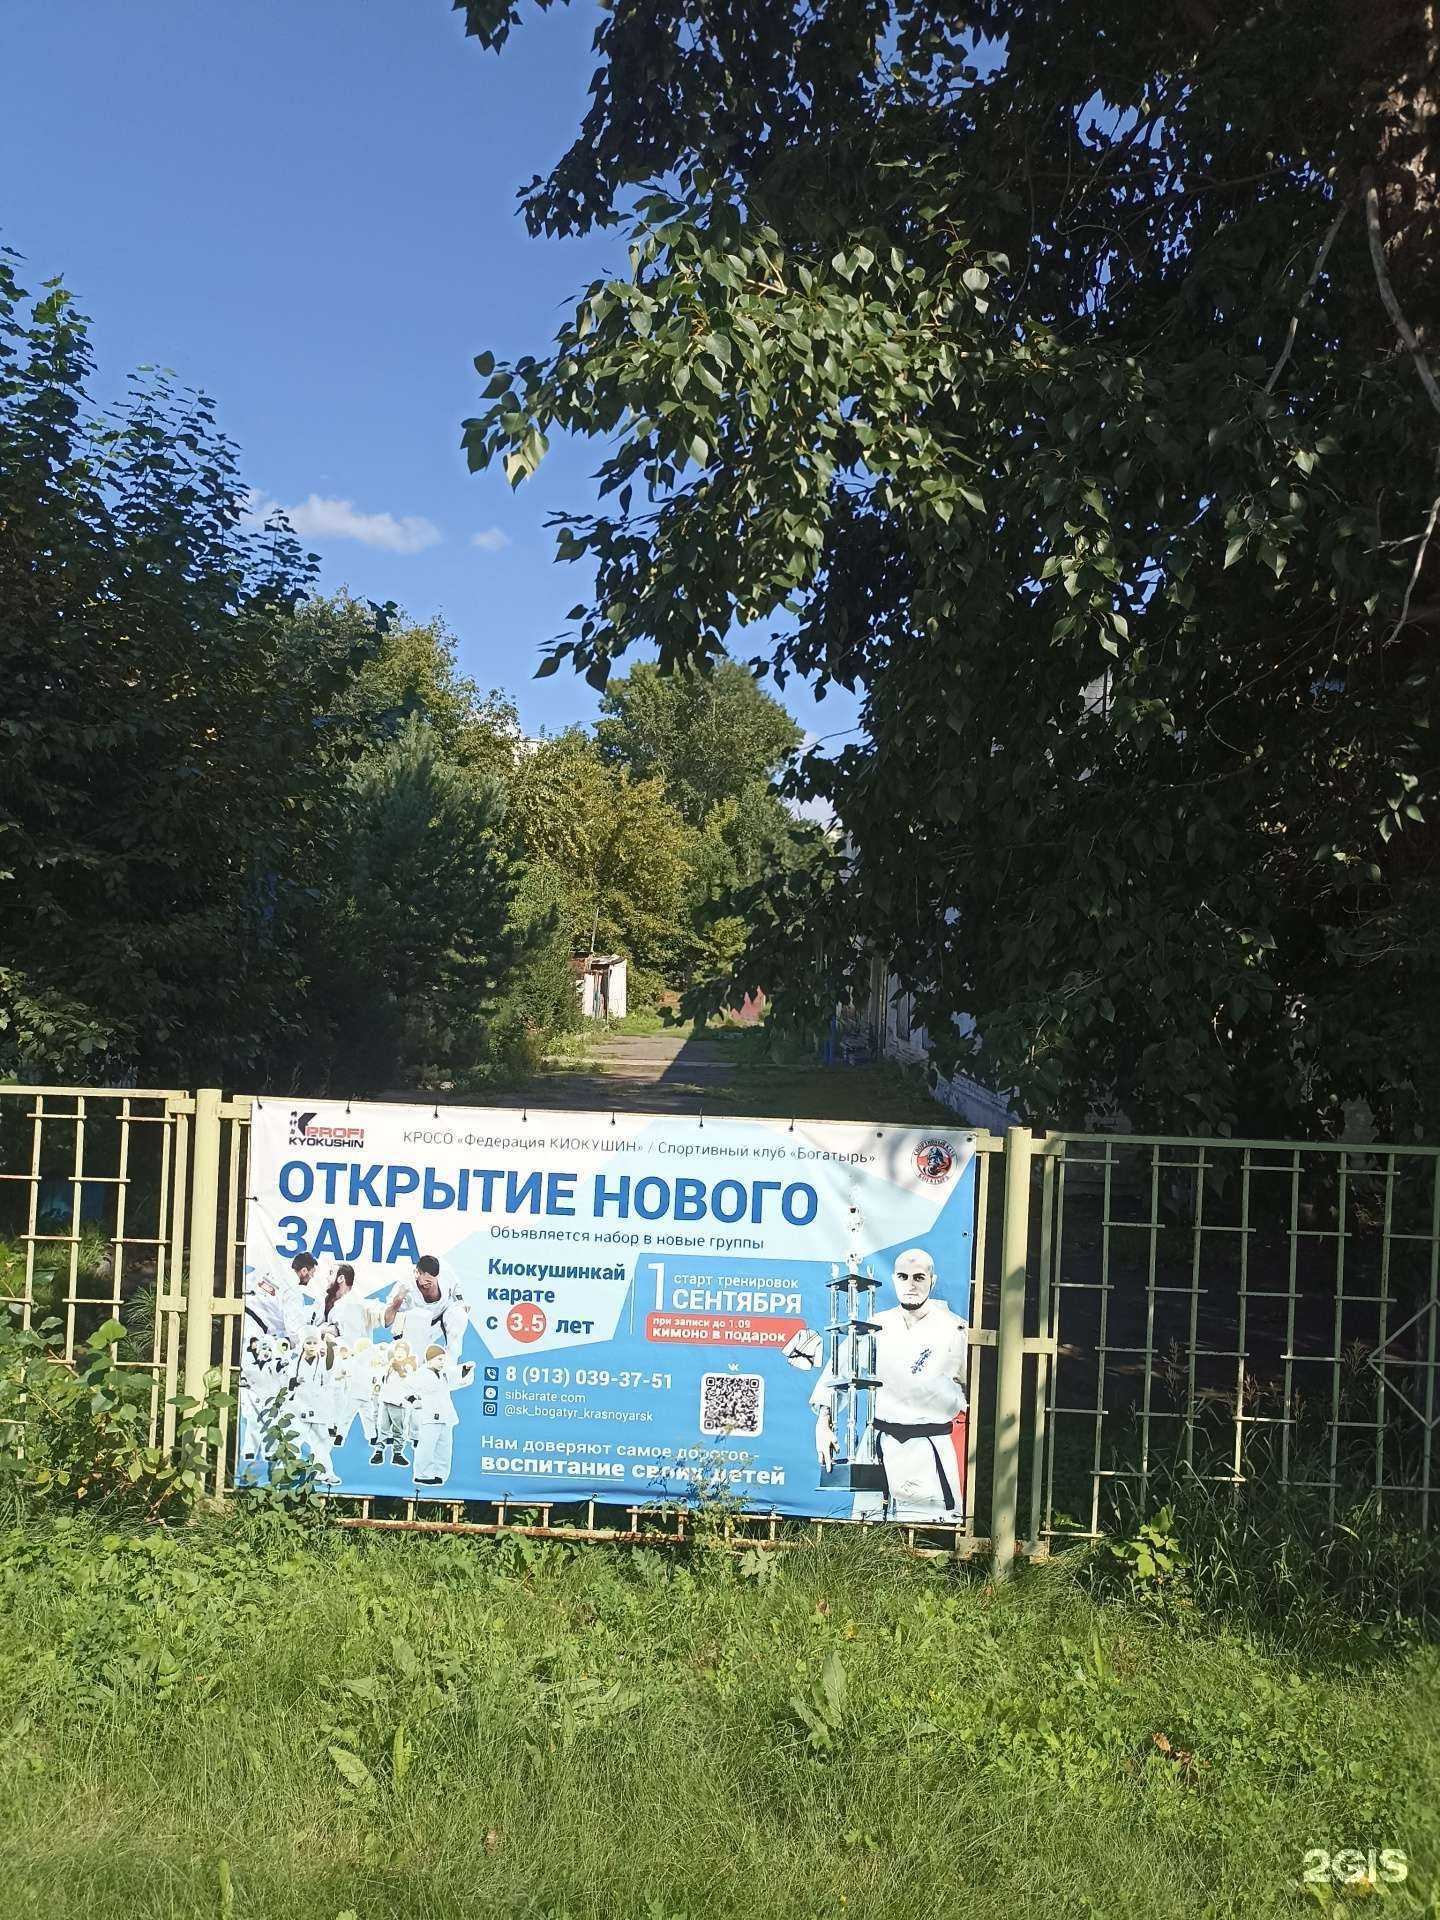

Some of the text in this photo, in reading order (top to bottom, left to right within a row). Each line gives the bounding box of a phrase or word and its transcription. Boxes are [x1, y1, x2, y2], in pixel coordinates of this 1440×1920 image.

[288, 1137, 364, 1149] KYOKUSHIN
[403, 1131, 453, 1145] КРОСО
[457, 1133, 546, 1150] «Федерация
[549, 1138, 643, 1153] КИОКУШИН»
[658, 1141, 749, 1158] Спортивный
[753, 1148, 786, 1159] клуб
[790, 1147, 875, 1164] «Богатырь»
[279, 1160, 818, 1227] ОТКРЫТИЕ НОВОГО
[275, 1215, 421, 1266] ЗАЛА
[490, 1225, 764, 1251] Объявляется набор в новые группы
[488, 1258, 625, 1281] Киокушинкай
[647, 1262, 665, 1311] 1
[673, 1274, 799, 1289] старт тренировок
[487, 1287, 555, 1305] карате
[672, 1288, 802, 1314] СЕНТЯБРЯ
[486, 1312, 594, 1335] с 3.5 лет
[652, 1317, 671, 1327] при
[712, 1320, 725, 1329] до
[652, 1327, 786, 1344] кимоно в подарок
[506, 1366, 672, 1389] 8 (913) 039-37-51
[504, 1389, 586, 1403] sibkarate.com
[504, 1405, 653, 1423] @sk_bogatyr_krasnoyarsk
[481, 1435, 518, 1450] Нам
[522, 1439, 611, 1456] доверяют
[616, 1445, 672, 1458] самое
[481, 1456, 625, 1477] воспитание
